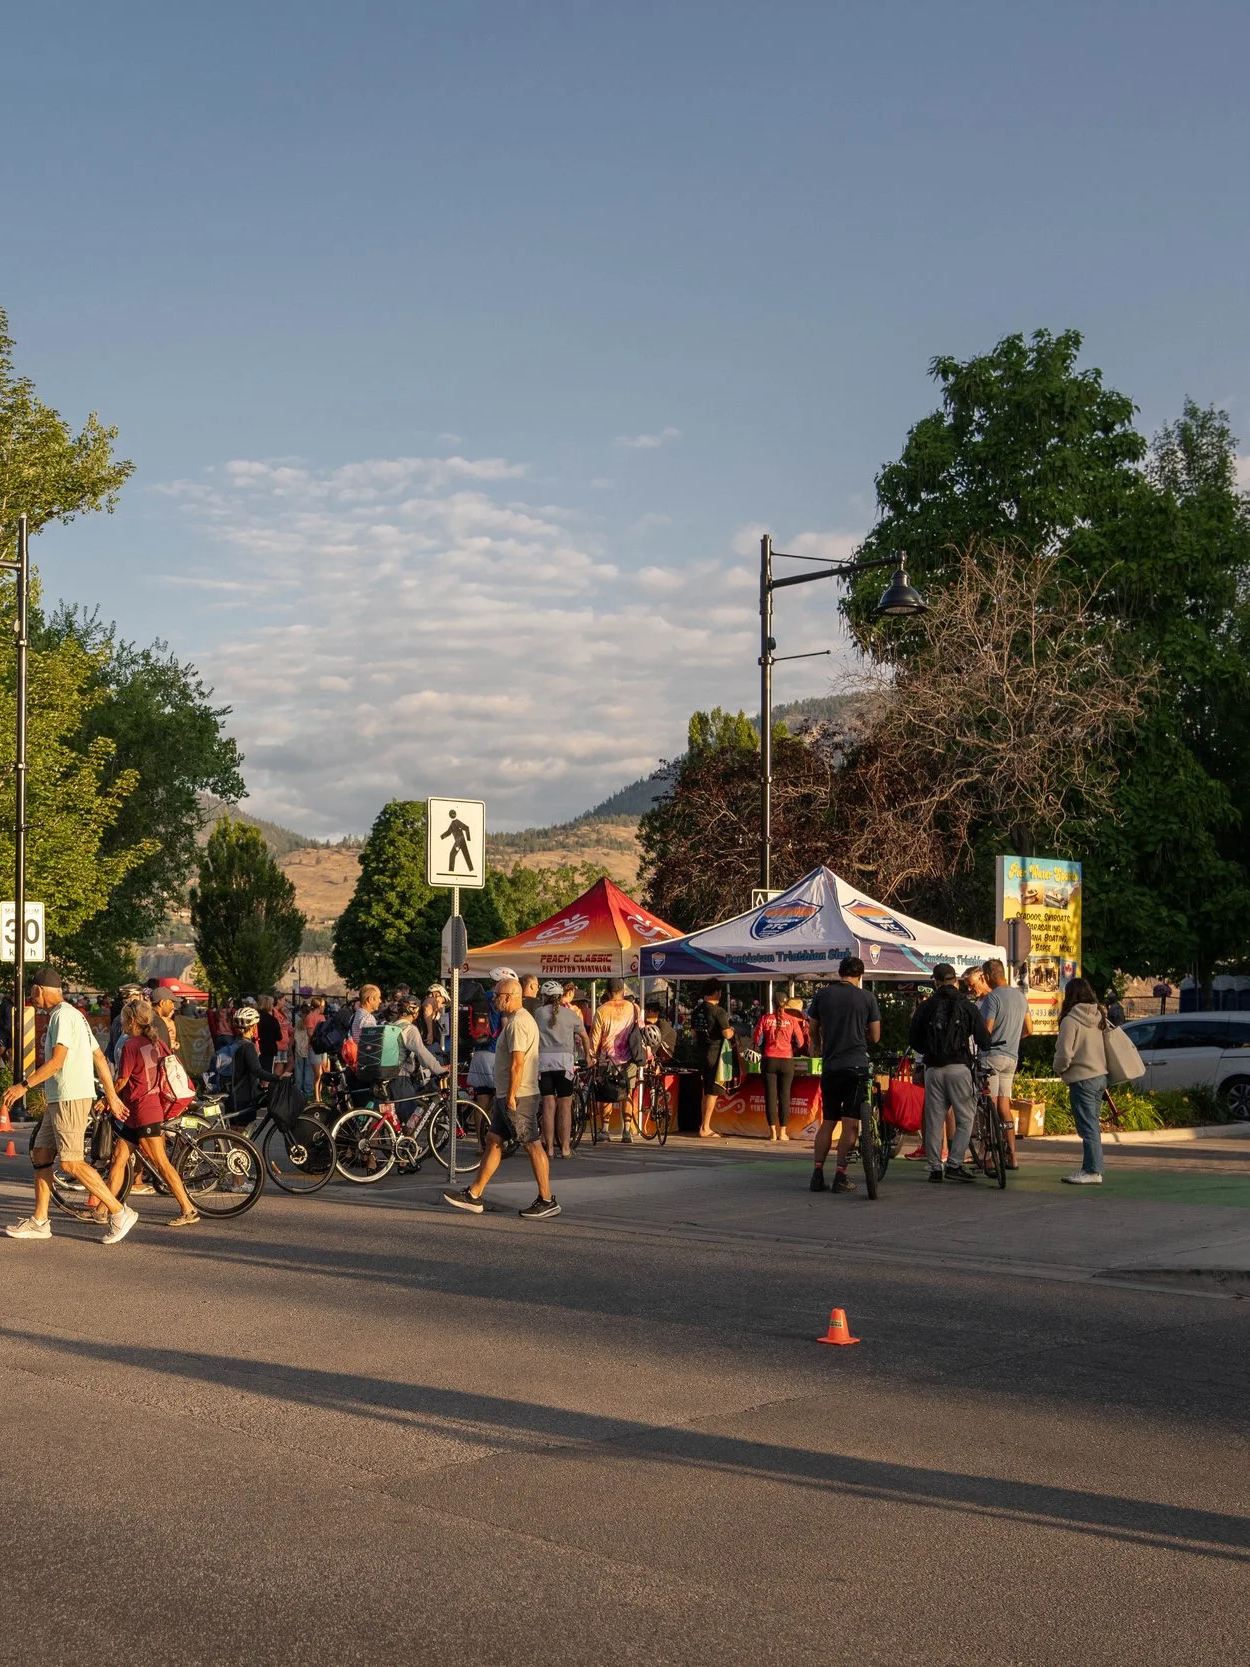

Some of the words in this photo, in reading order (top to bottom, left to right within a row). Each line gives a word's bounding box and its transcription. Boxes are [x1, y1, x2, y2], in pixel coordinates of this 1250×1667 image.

[1030, 864, 1053, 880] Water
[1053, 866, 1079, 883] Sports
[540, 954, 570, 963] PEACH
[573, 954, 613, 963] CLASSIC
[726, 952, 775, 964] Penticton
[776, 949, 827, 962] Triathlon
[828, 947, 852, 960] Club
[922, 952, 956, 965] Penticton
[542, 965, 576, 973] PENTICTON
[577, 965, 612, 973] TRIATHLON
